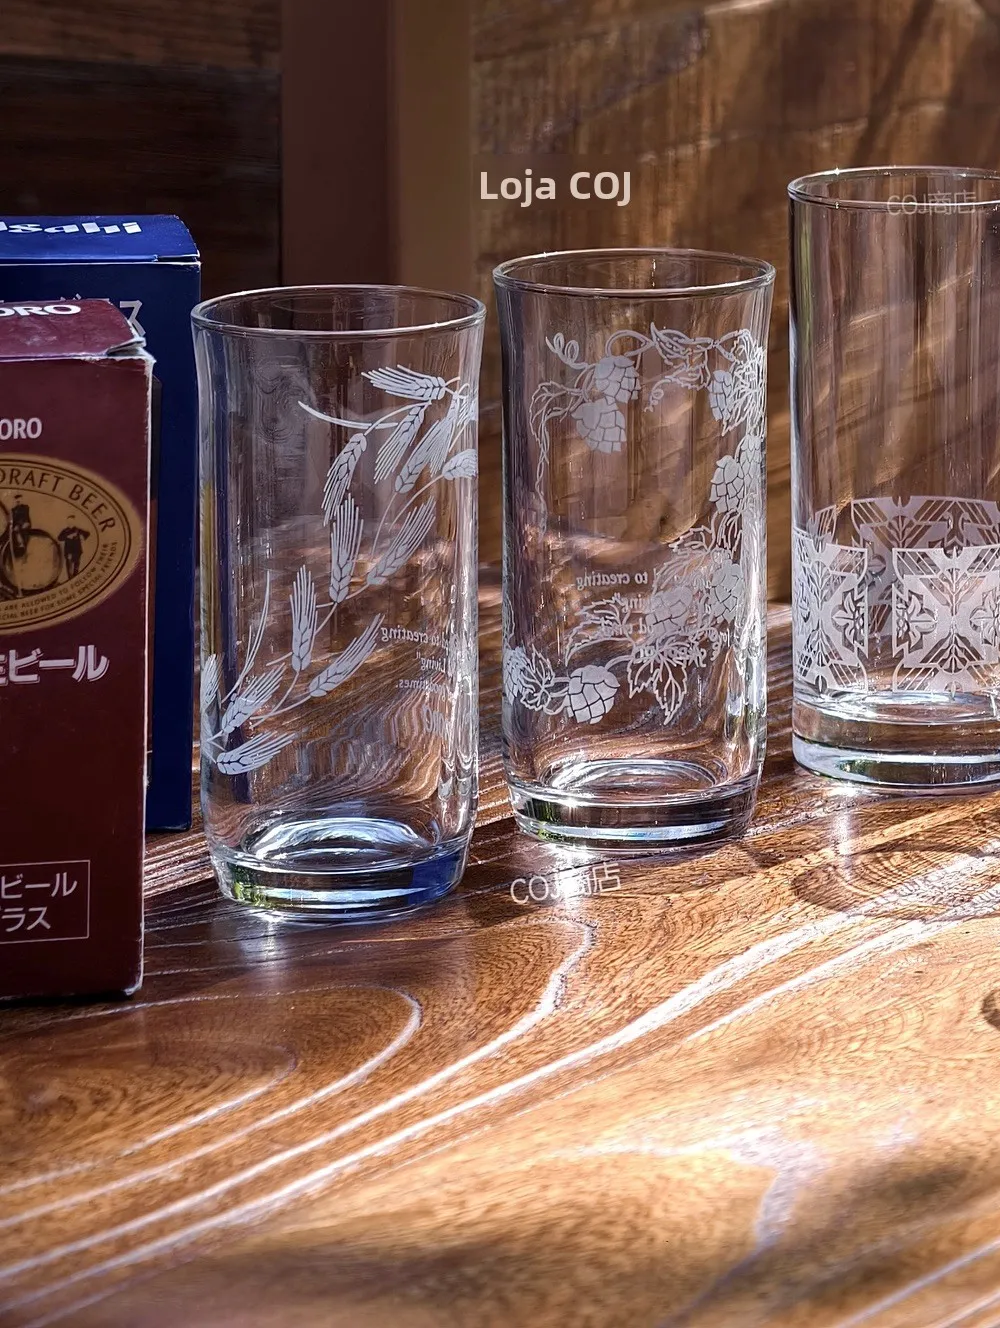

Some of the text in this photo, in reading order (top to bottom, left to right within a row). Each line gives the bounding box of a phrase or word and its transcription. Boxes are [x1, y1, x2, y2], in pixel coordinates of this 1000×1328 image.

[0, 222, 142, 234] sahi
[69, 484, 116, 534] BEER
[0, 644, 110, 686] ビール
[0, 906, 51, 933] ラス
